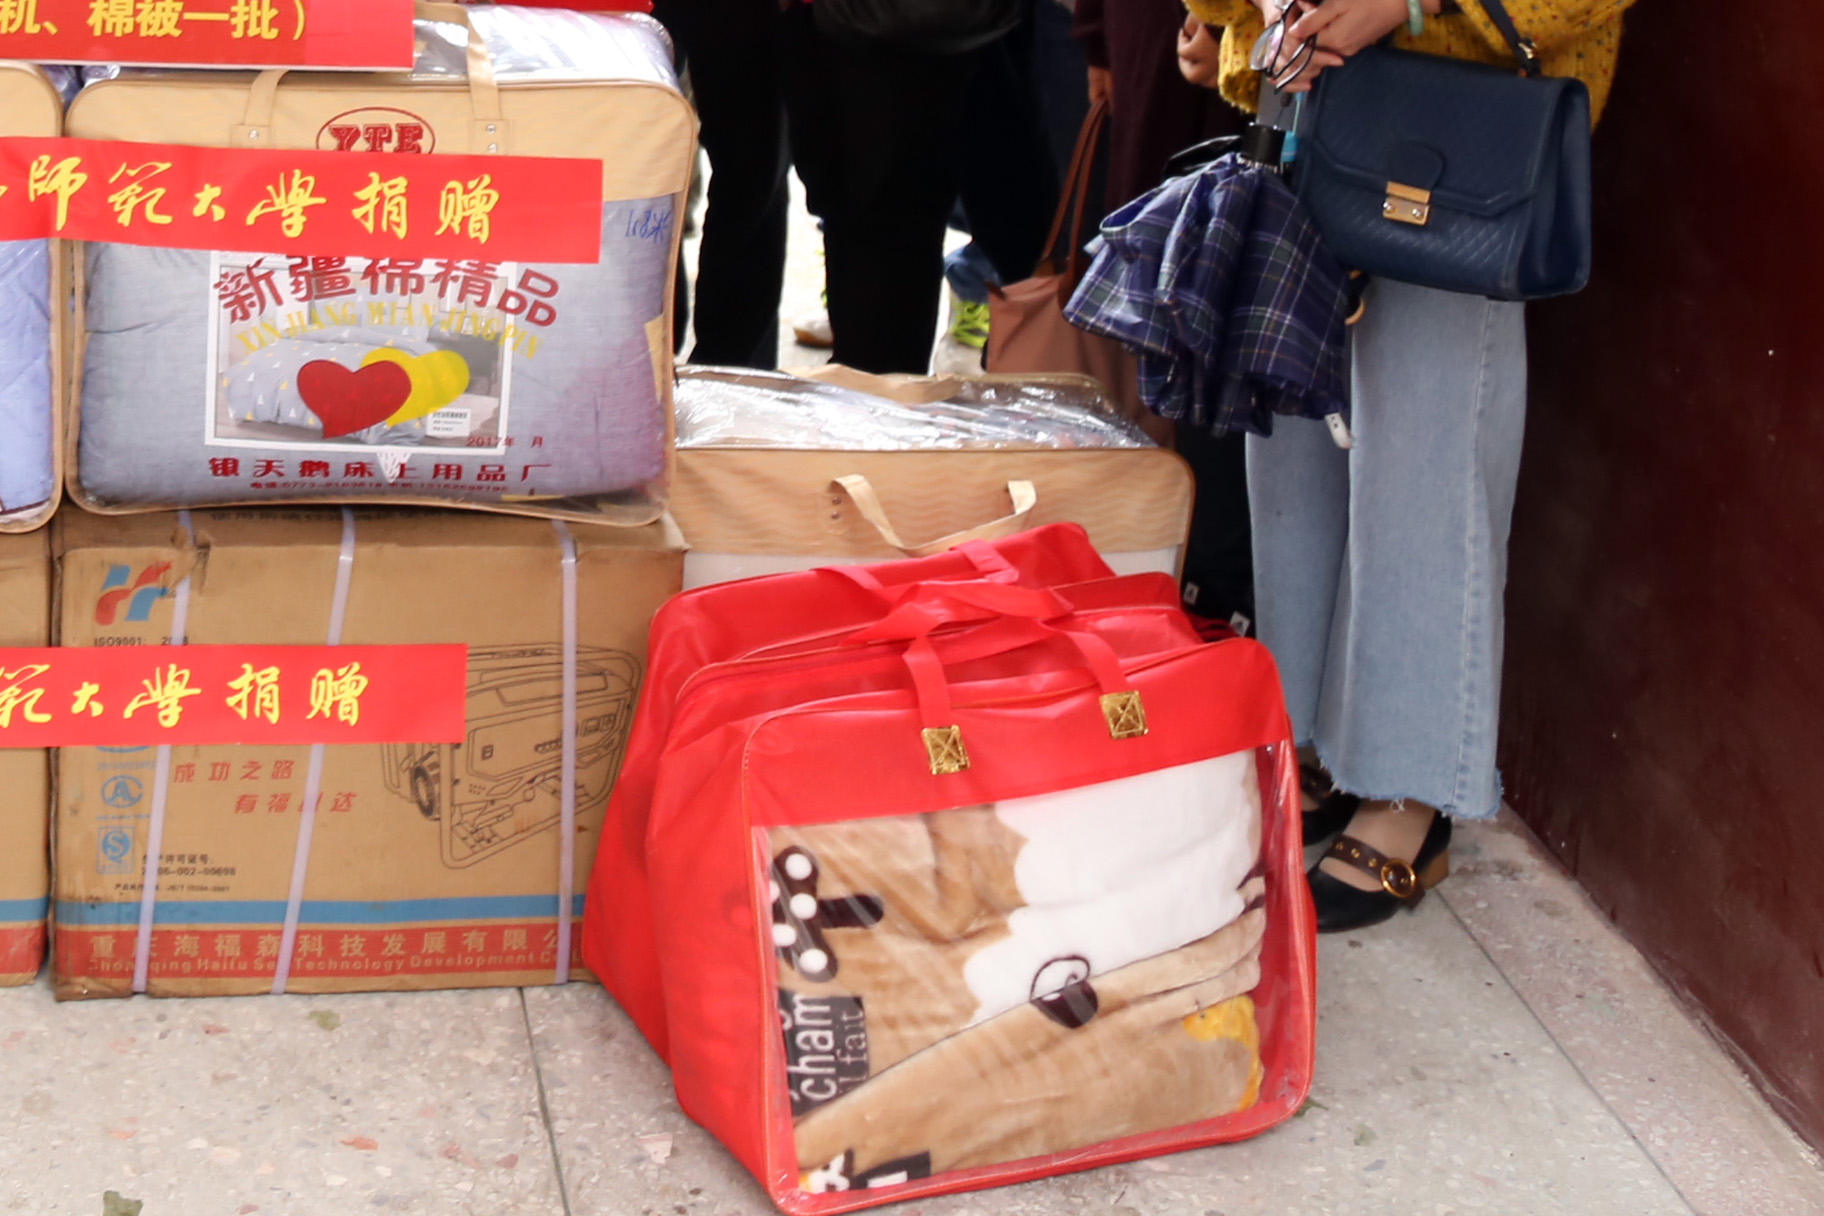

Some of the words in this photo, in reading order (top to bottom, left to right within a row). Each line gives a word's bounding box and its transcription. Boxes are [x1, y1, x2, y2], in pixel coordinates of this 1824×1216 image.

[327, 122, 425, 154] YTE
[209, 457, 553, 482] 银天鹅床上用品厂
[174, 759, 295, 784] 成功之路
